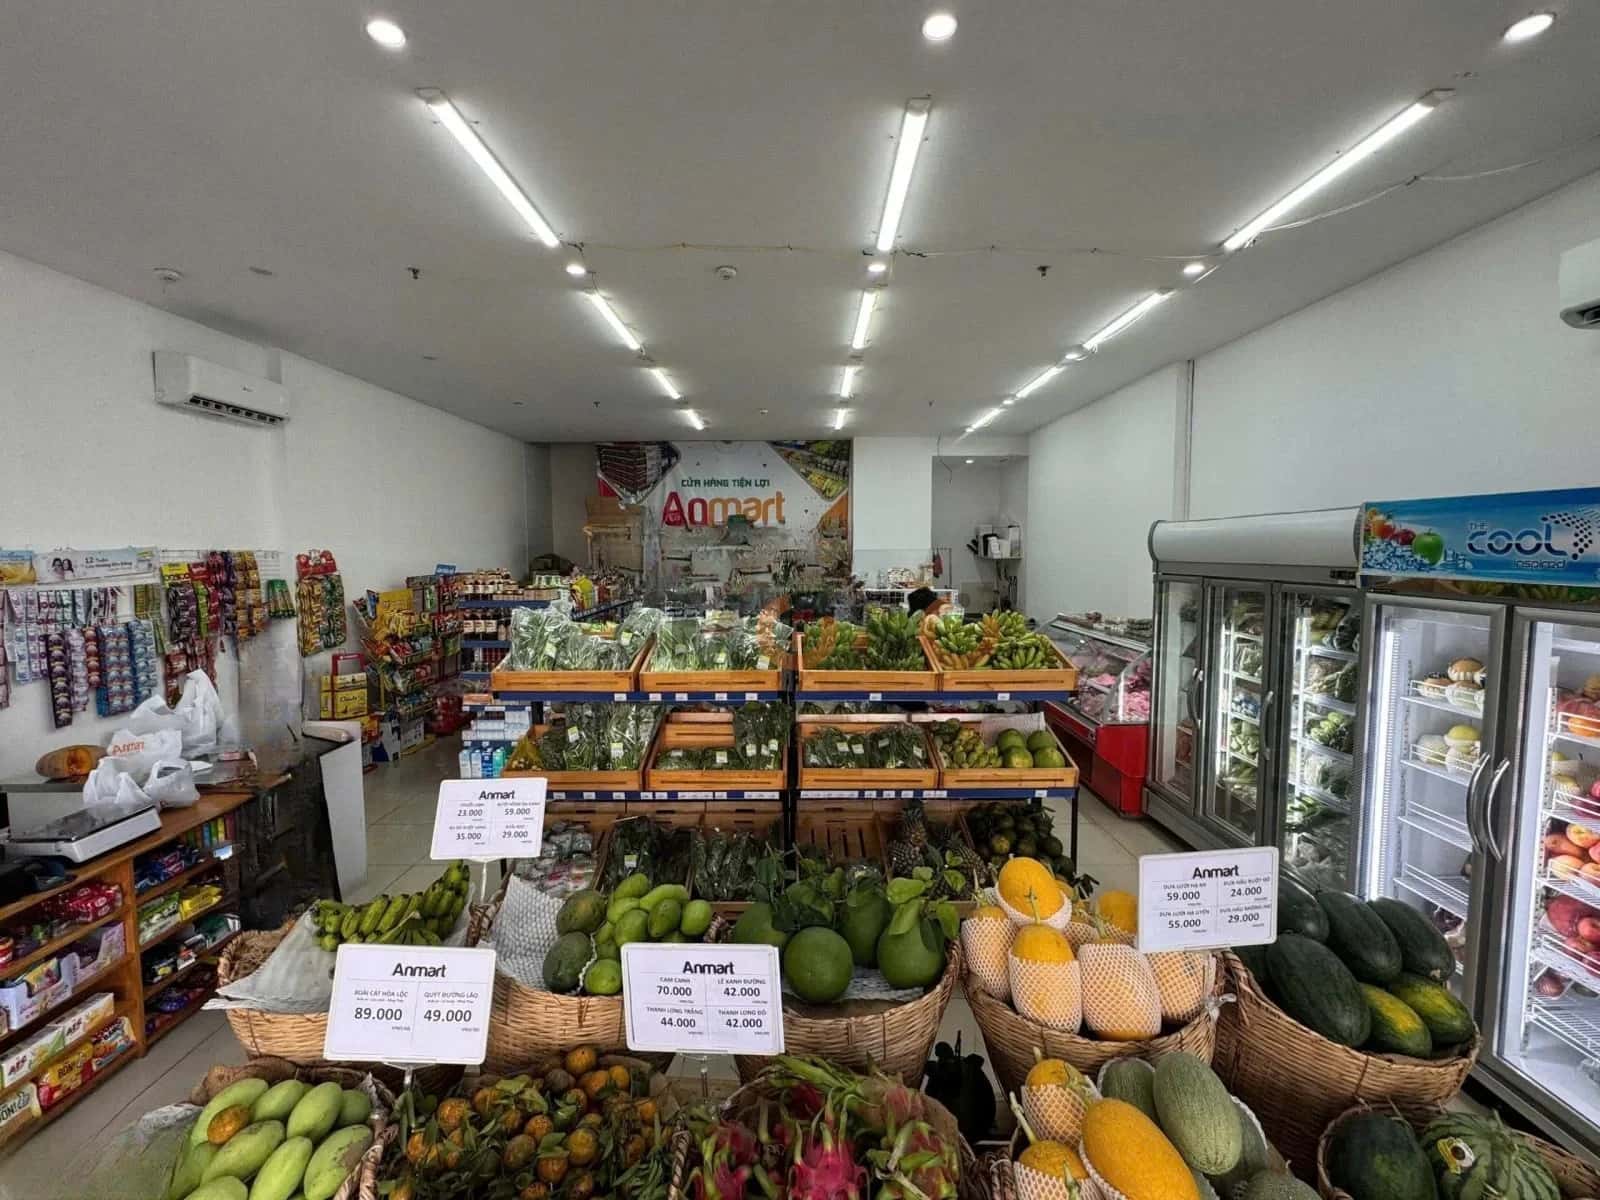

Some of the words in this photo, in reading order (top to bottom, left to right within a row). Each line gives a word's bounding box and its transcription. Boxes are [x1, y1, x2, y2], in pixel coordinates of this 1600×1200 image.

[479, 790, 515, 800] Anmart
[1192, 865, 1239, 880] Anmart
[1167, 891, 1201, 901] 59.000
[1230, 886, 1262, 897] 24.000
[1168, 918, 1201, 928] 55.000
[1228, 912, 1260, 923] 29.000
[392, 963, 447, 978] Anmart
[682, 961, 735, 975] Anmart
[657, 985, 692, 996] 70.000
[723, 987, 761, 997] 42.000
[354, 1007, 403, 1021] 89.000
[423, 1009, 472, 1022] 49.000
[661, 1017, 696, 1028] 44.000
[725, 1018, 763, 1028] 42.000
